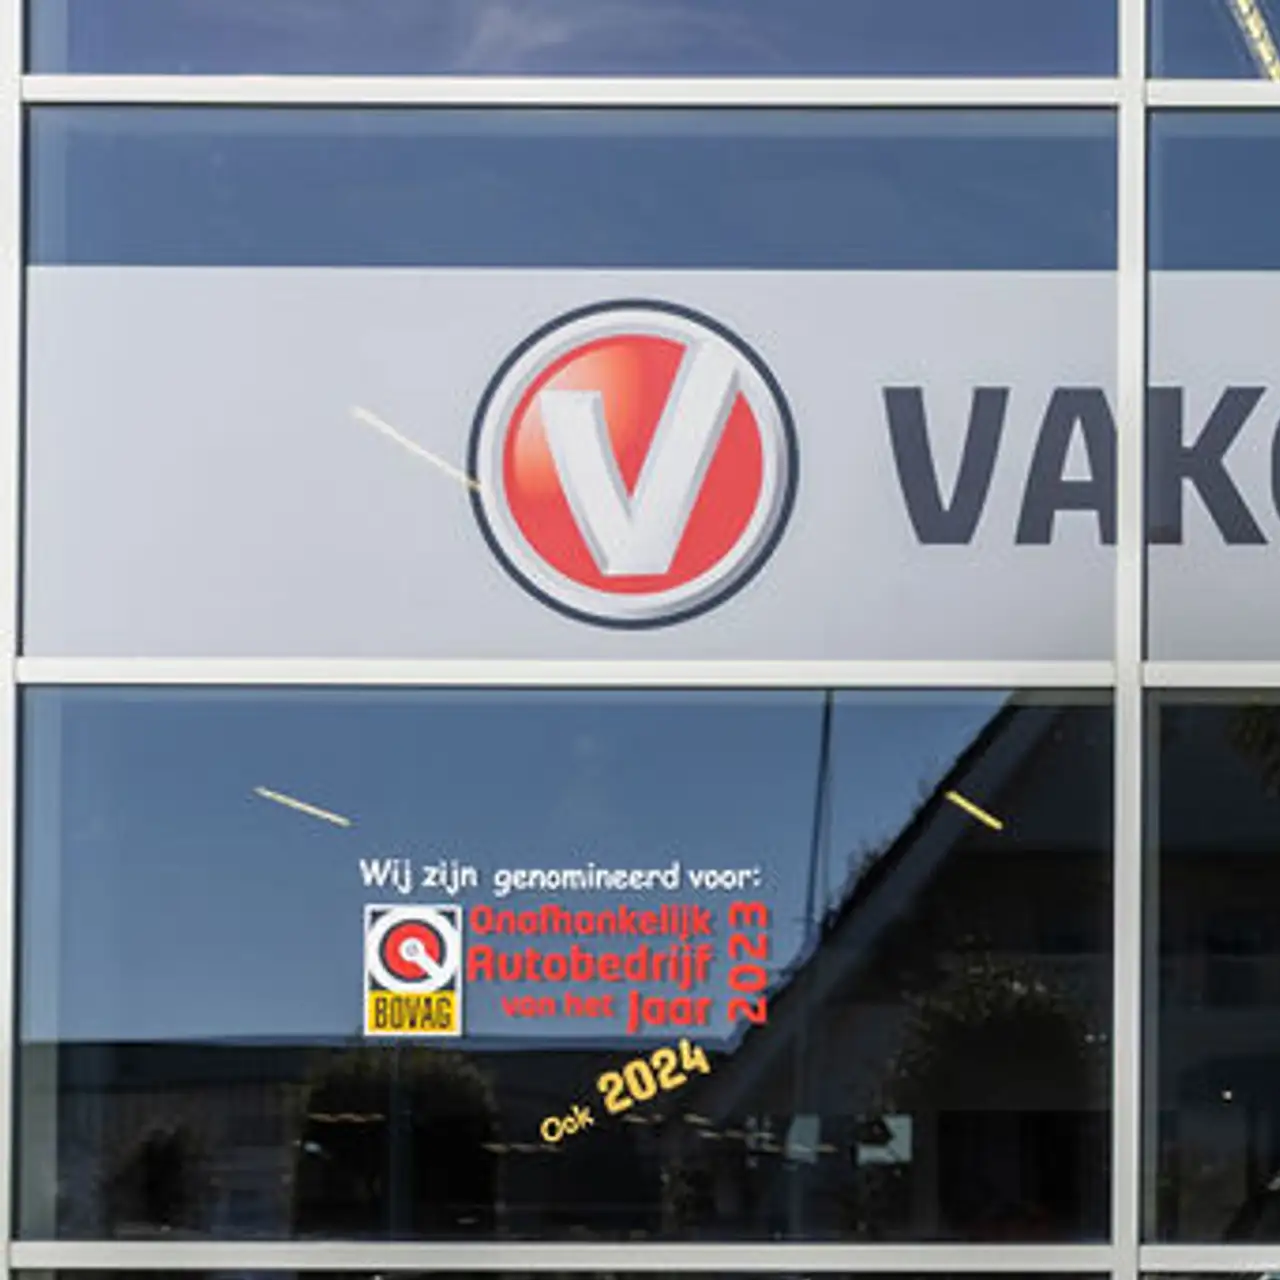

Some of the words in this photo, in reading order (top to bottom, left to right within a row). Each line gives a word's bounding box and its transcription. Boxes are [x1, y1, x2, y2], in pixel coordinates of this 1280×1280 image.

[359, 858, 413, 895] Wij
[421, 859, 478, 896] zijn
[493, 860, 681, 898] genomineerd
[688, 866, 762, 889] voor:
[466, 943, 714, 992] Autobedrijf
[727, 900, 768, 1025] 2023
[374, 996, 451, 1029] BOVAG
[500, 994, 557, 1018] van
[562, 991, 614, 1019] het
[539, 1105, 595, 1143] Ook
[597, 1037, 711, 1115] 2024
